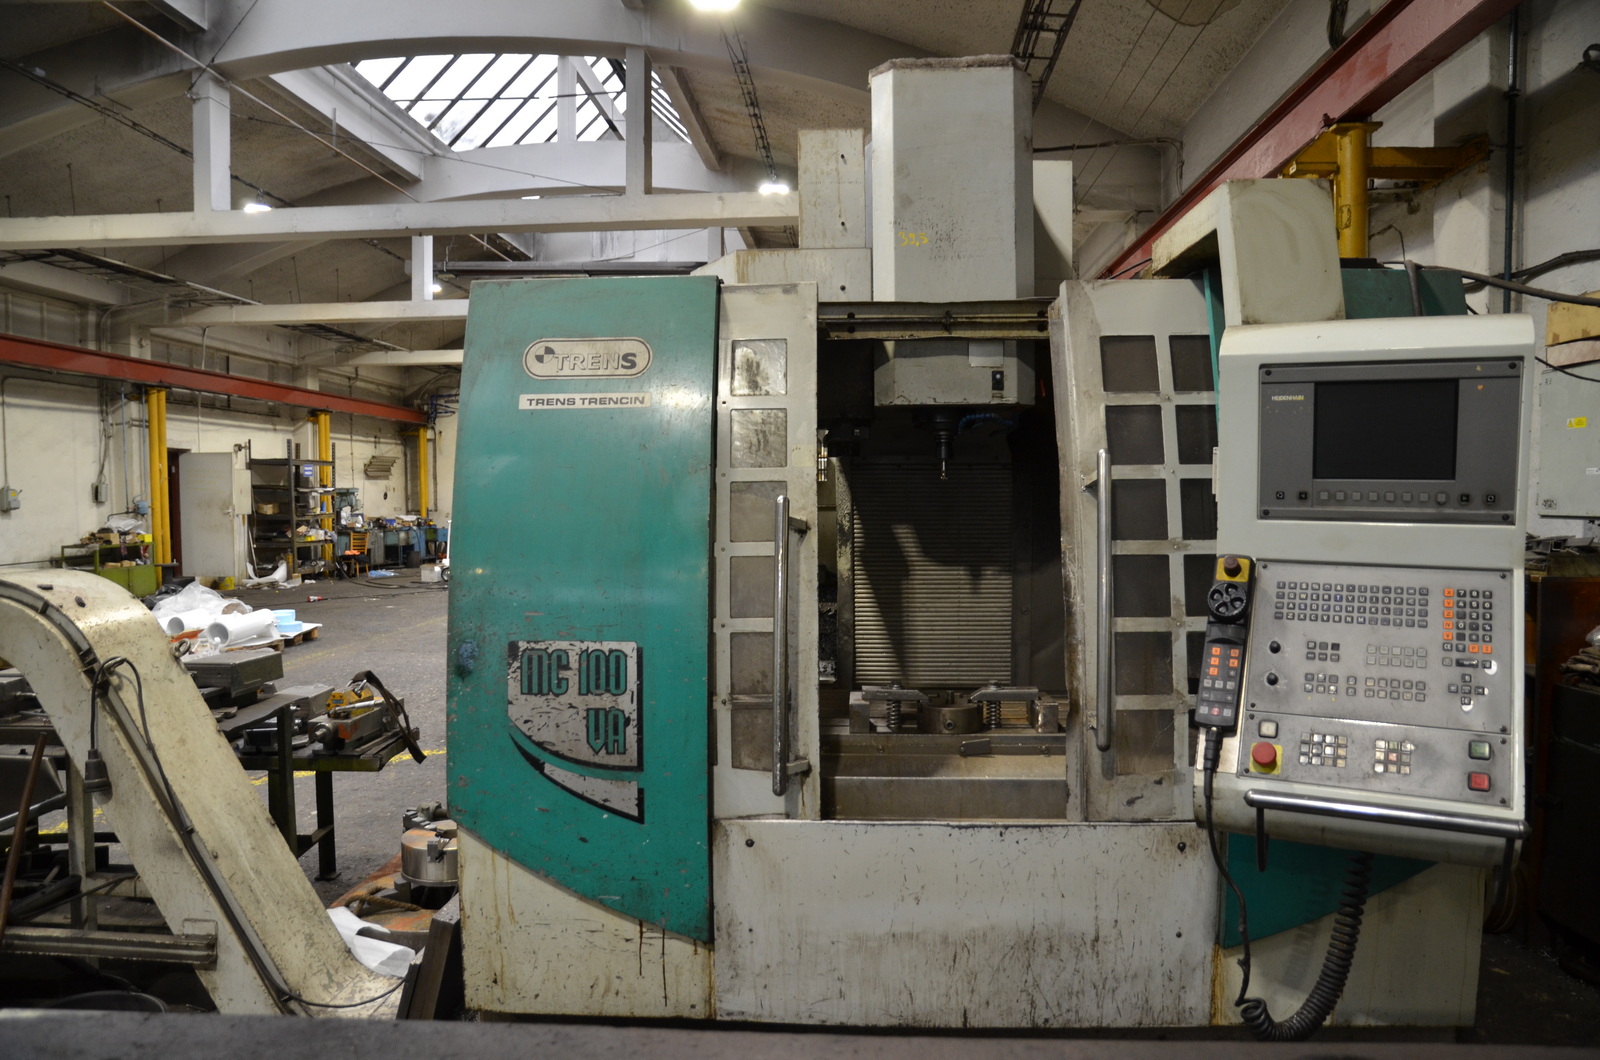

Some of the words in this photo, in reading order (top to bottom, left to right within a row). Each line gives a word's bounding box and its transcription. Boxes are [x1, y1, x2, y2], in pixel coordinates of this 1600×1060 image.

[554, 352, 637, 371] TRENS
[526, 397, 576, 406] TRENS
[580, 396, 645, 405] TRENCIN
[521, 648, 570, 696] MC
[578, 648, 628, 696] 100
